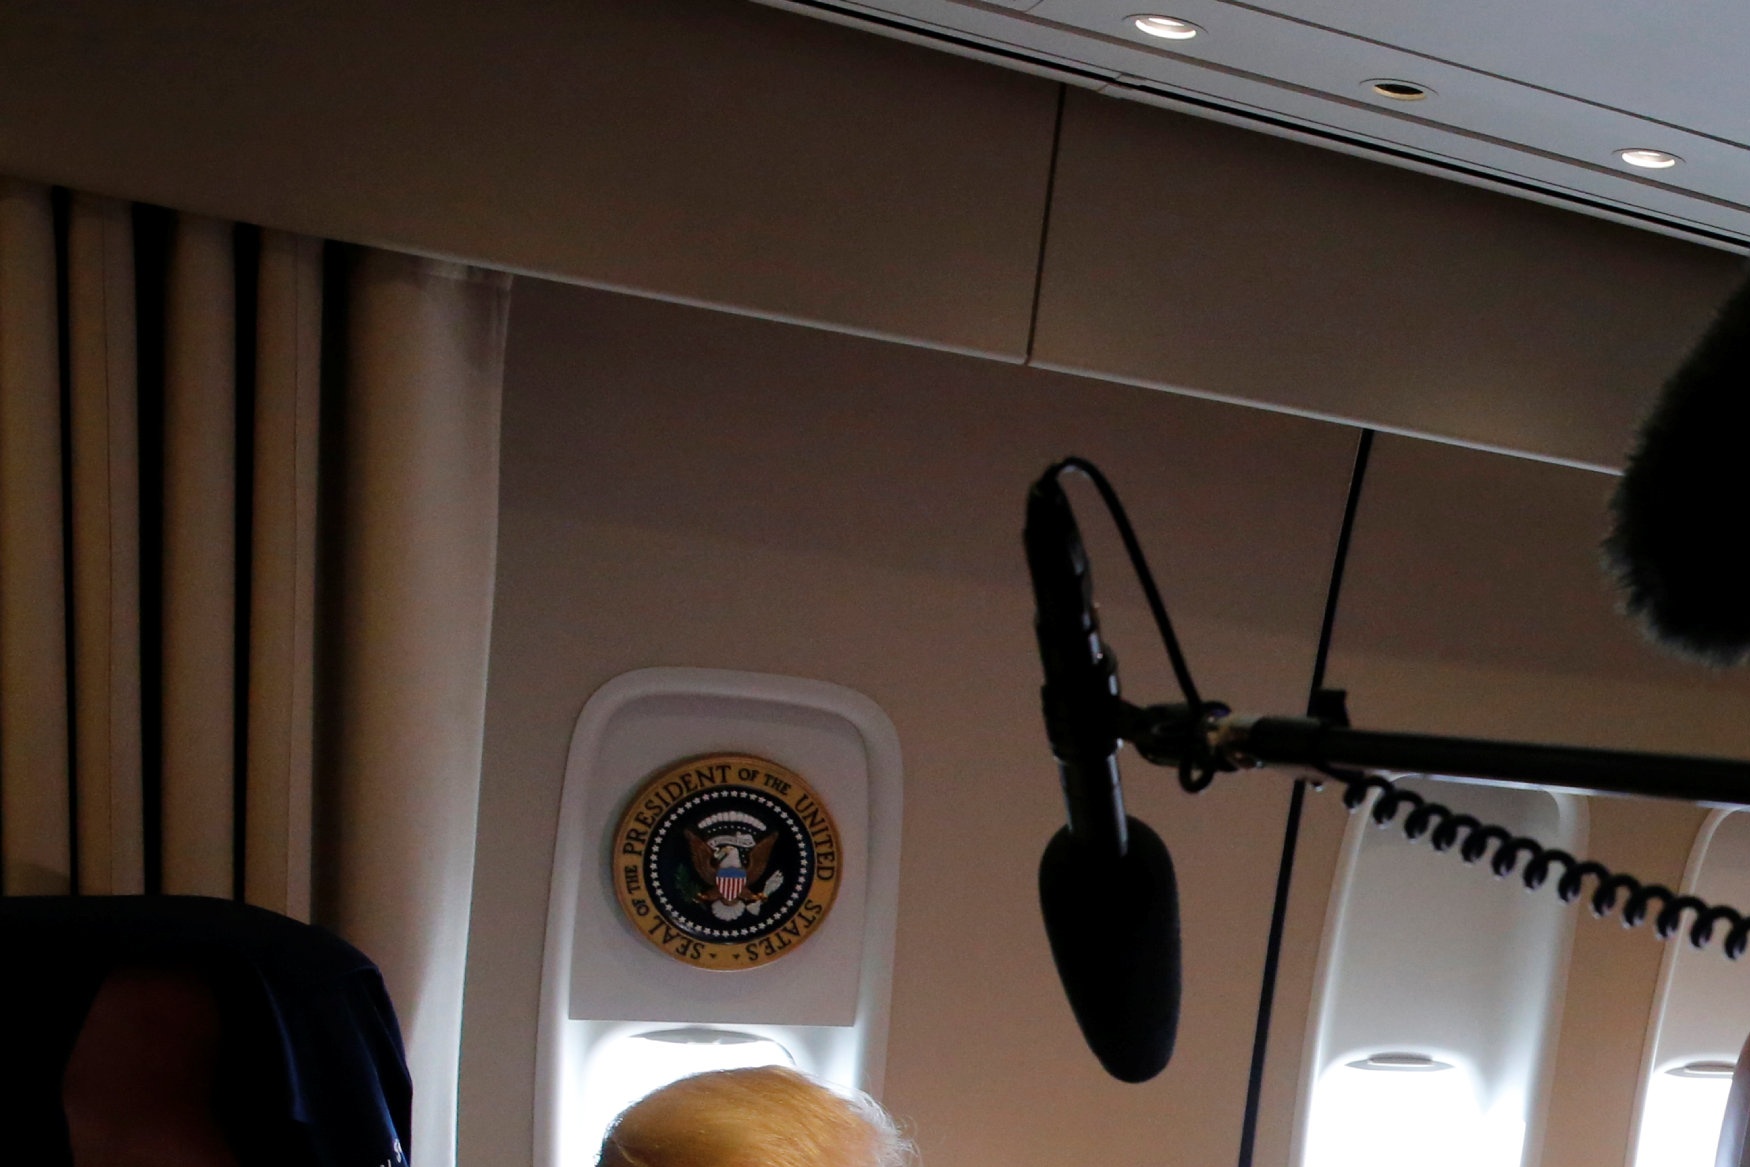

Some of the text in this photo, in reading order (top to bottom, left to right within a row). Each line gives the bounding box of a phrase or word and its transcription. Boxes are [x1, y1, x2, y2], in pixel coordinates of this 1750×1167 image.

[623, 765, 836, 961] SEAL OF THE PRESIDENT OF THE UNITED STATES
